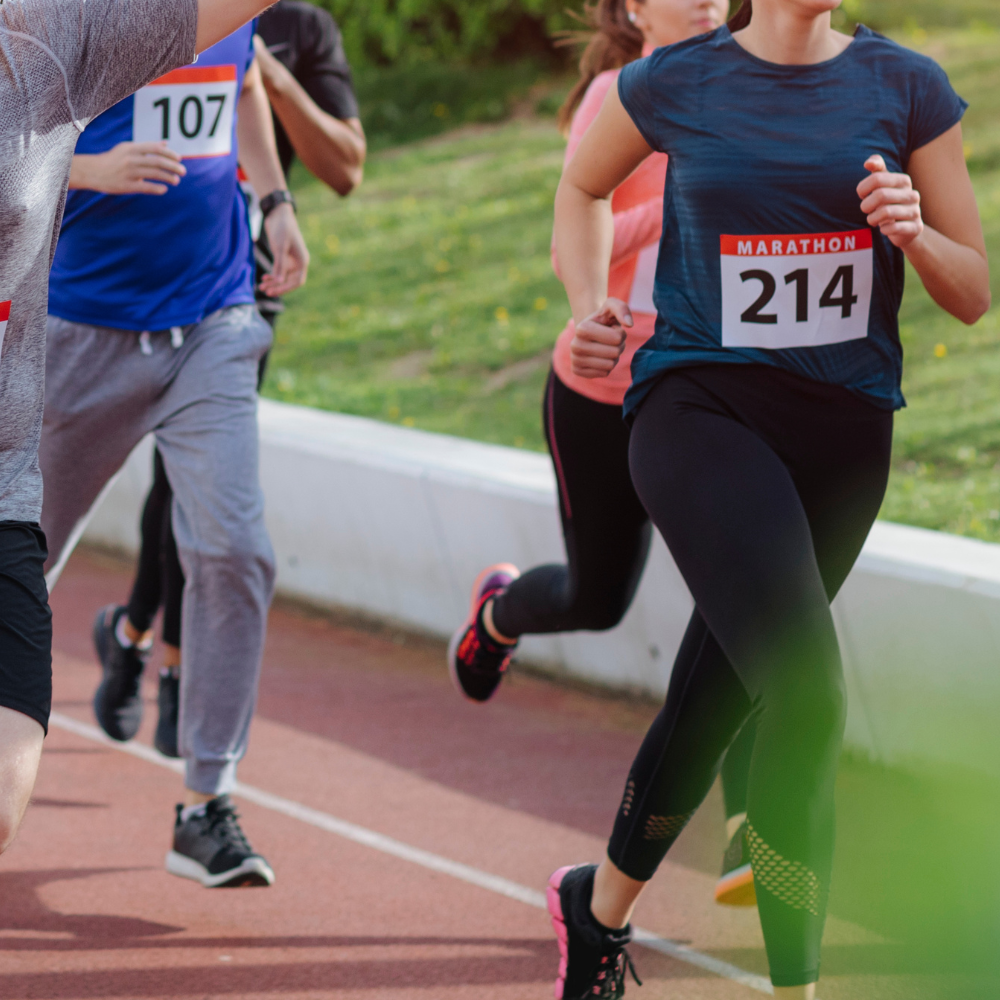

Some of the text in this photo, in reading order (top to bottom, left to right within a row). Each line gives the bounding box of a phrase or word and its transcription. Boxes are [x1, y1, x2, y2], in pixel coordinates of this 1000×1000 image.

[153, 95, 226, 139] 107
[737, 236, 856, 256] MARATHON
[739, 264, 858, 325] 214
